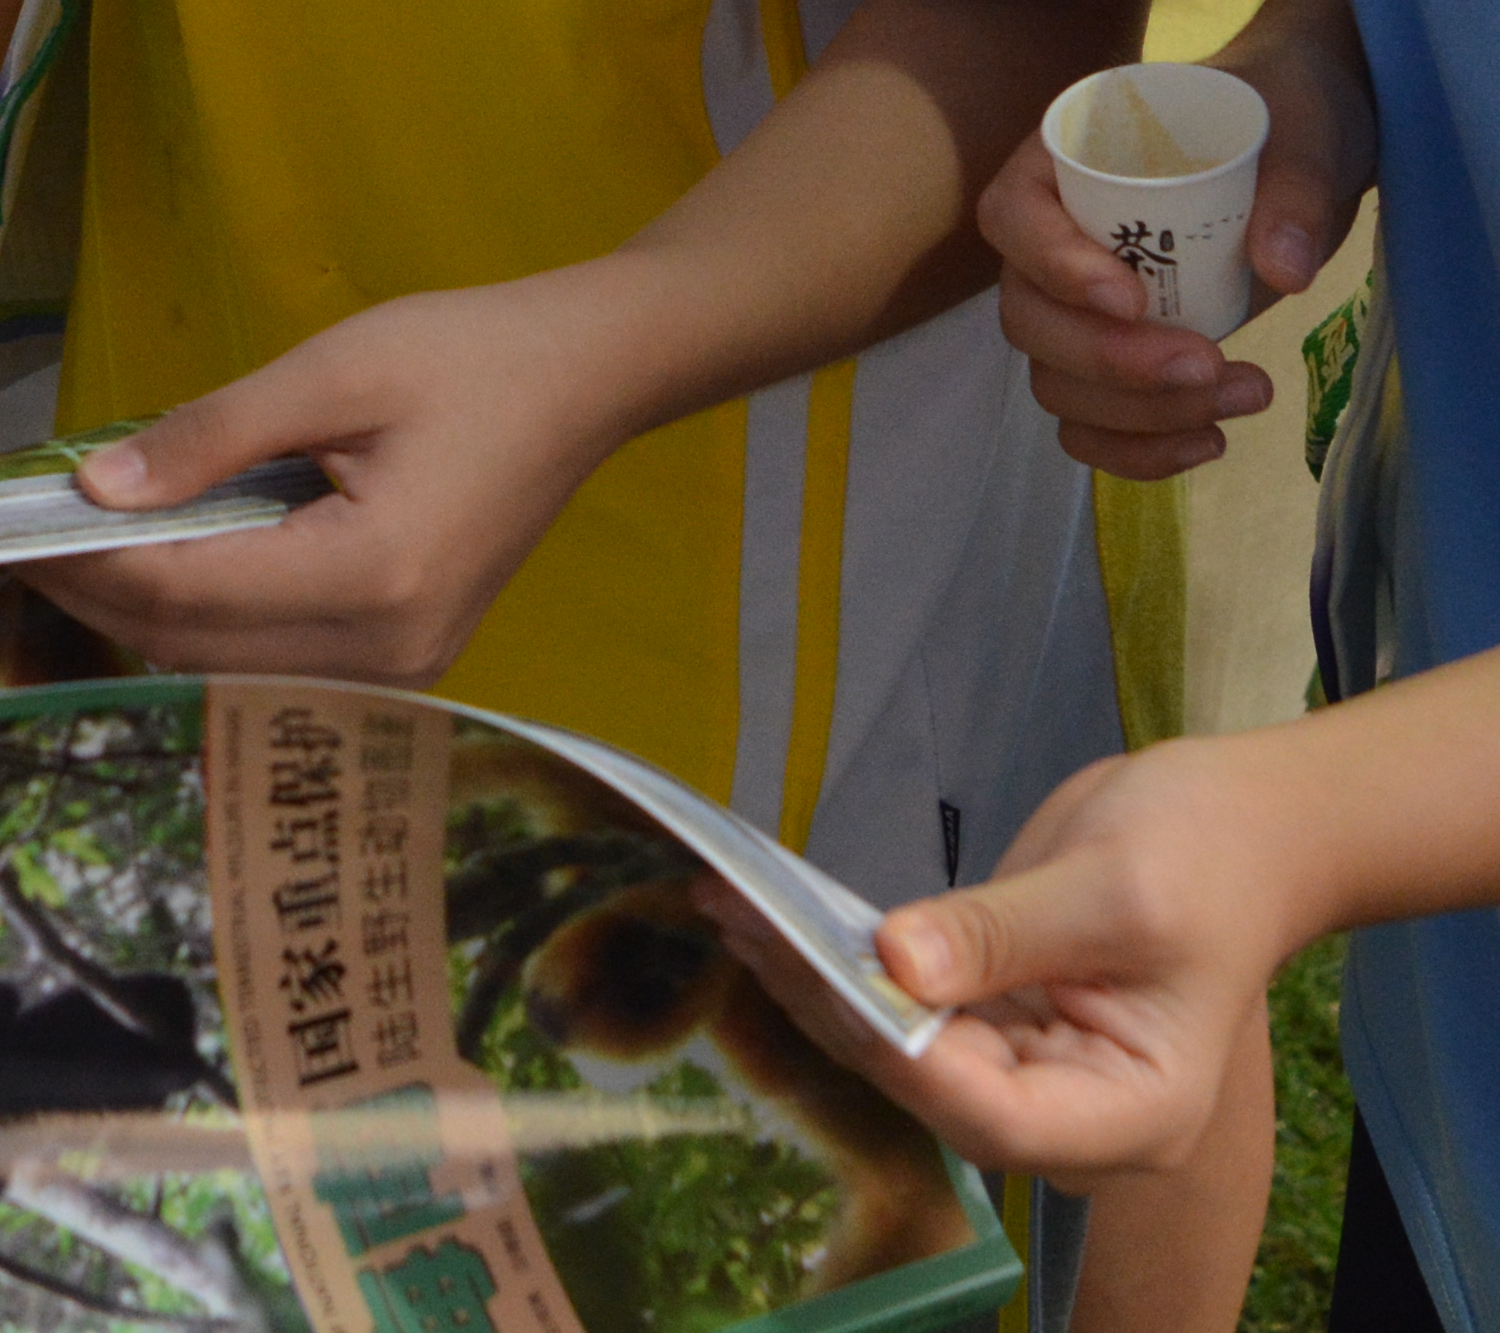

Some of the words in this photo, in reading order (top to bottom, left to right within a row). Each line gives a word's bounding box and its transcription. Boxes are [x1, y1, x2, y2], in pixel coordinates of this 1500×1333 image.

[1110, 220, 1177, 297] 茶
[267, 706, 360, 1087] 国家重点保护
